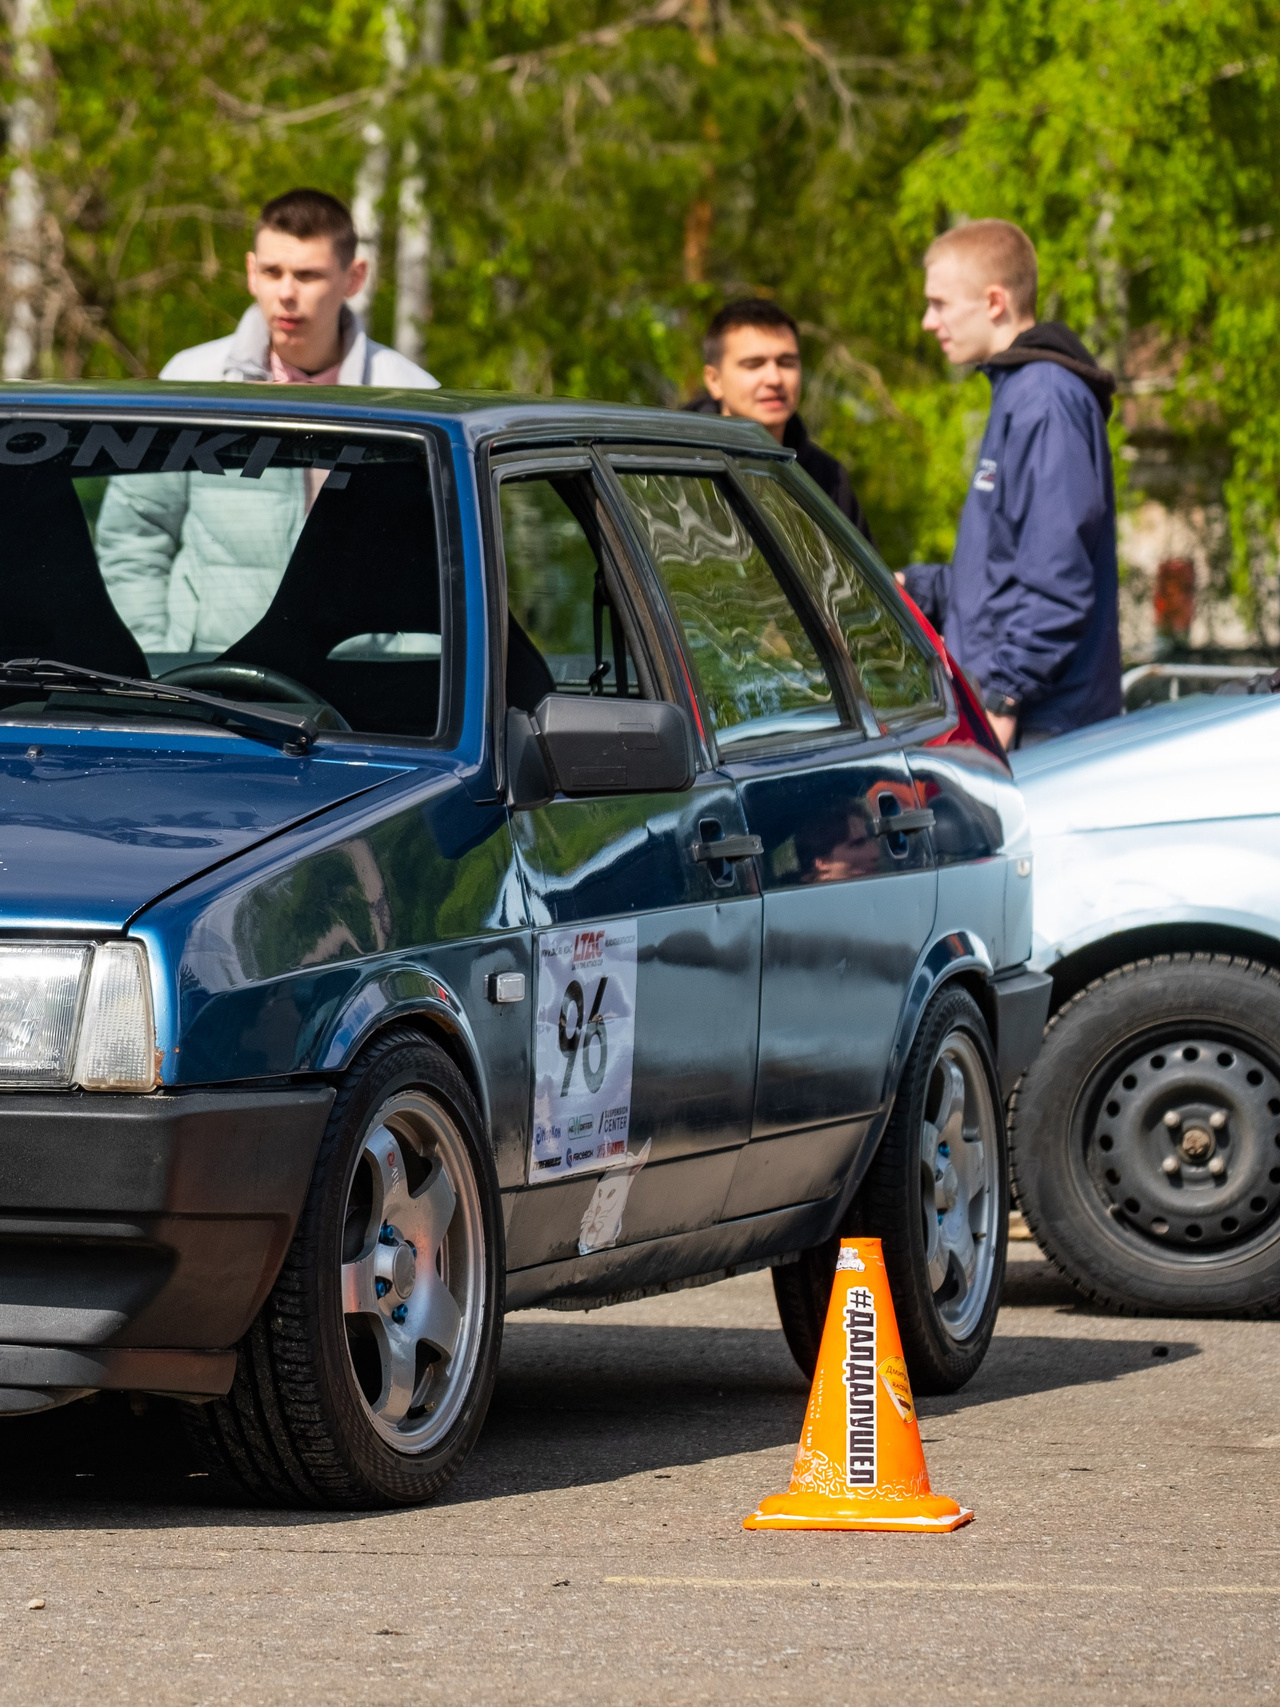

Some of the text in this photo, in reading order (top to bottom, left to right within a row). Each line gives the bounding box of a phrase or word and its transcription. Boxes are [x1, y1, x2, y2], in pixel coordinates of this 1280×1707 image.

[573, 931, 605, 961] LTAC
[559, 977, 607, 1097] 96
[604, 1115, 627, 1132] CENTER
[845, 1289, 875, 1485] #ДАЛДАЛУШЕЛ
